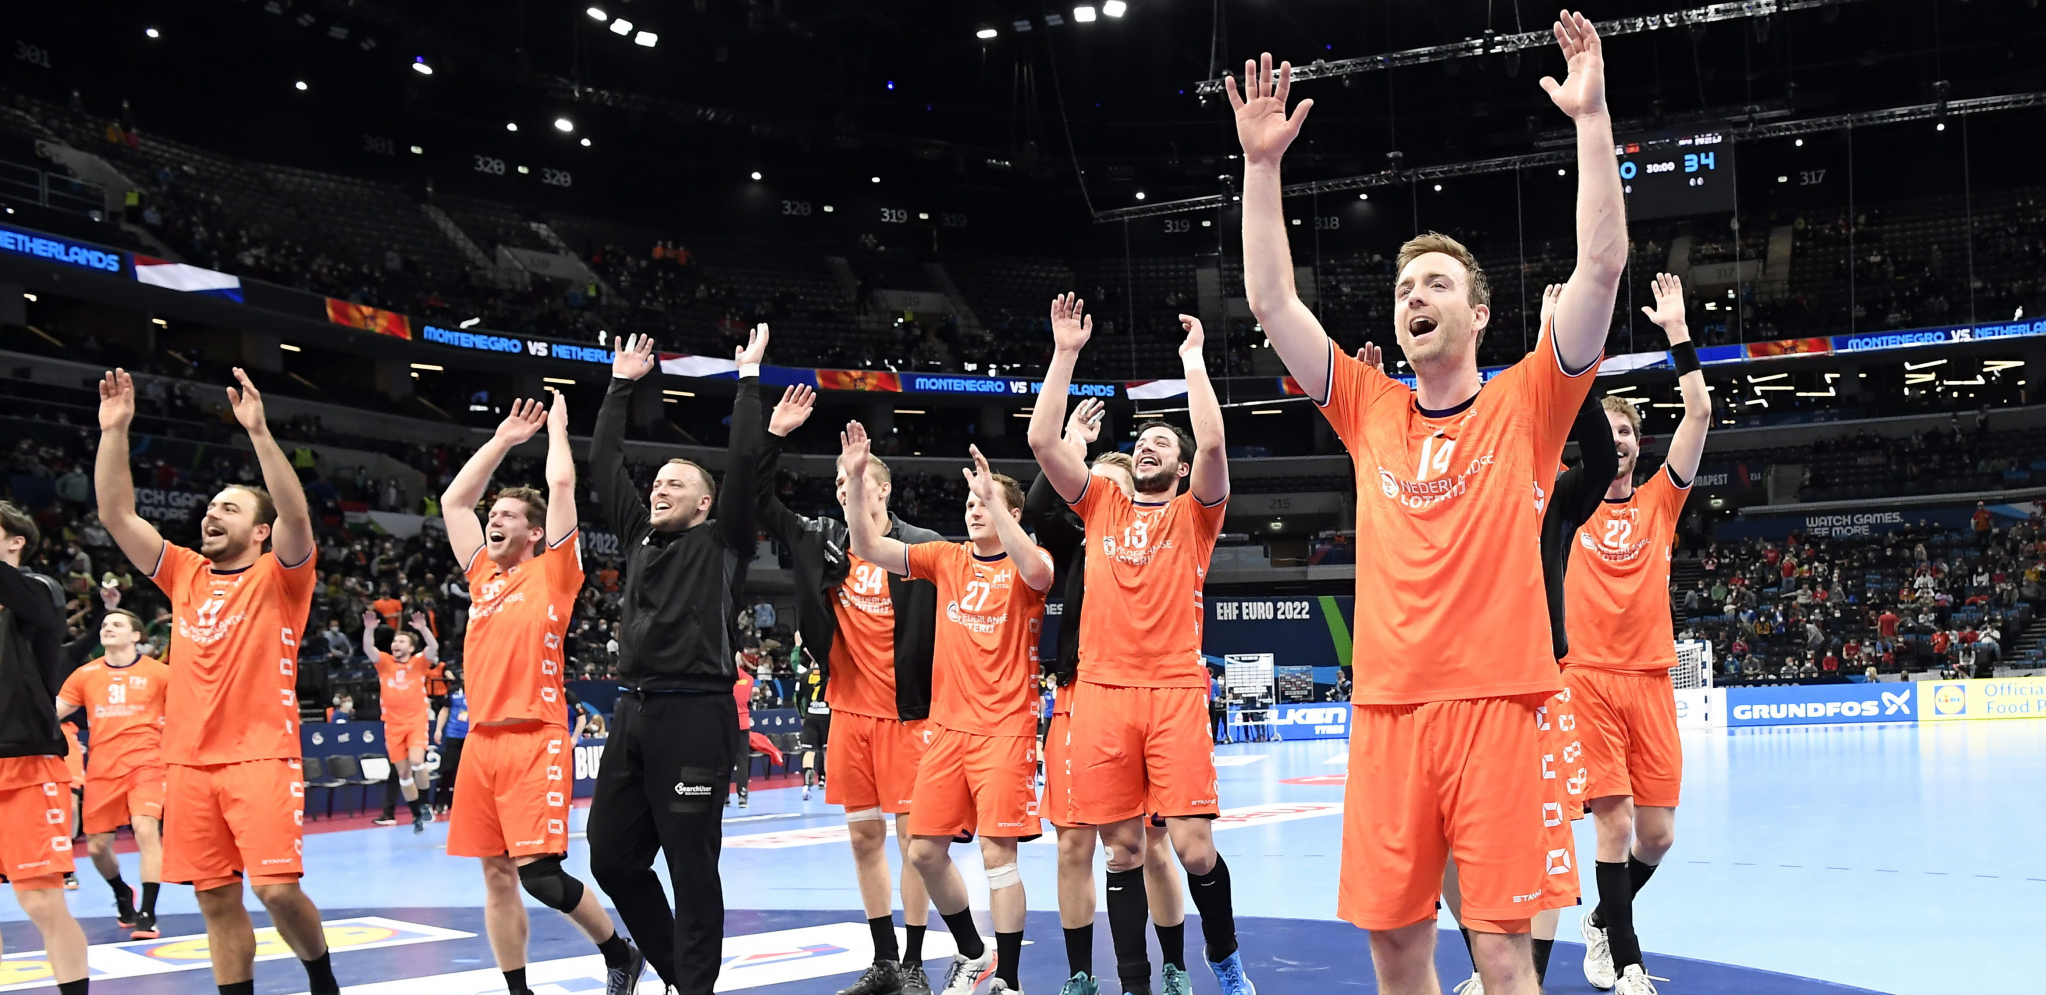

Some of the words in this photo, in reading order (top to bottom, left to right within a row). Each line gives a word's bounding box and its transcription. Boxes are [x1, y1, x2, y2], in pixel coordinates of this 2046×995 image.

[473, 154, 506, 176] 320
[1619, 161, 1637, 180] 0
[1646, 161, 1676, 174] 30:00
[1684, 151, 1715, 173] 34
[541, 167, 572, 187] 320
[1800, 169, 1826, 186] 317
[781, 199, 812, 217] 320
[880, 207, 908, 224] 319
[1164, 219, 1190, 233] 319
[1315, 216, 1340, 230] 318
[424, 326, 522, 353] MONTENEGRO
[526, 341, 548, 356] VS
[552, 344, 617, 364] NETHERL
[1848, 331, 1945, 351] MONTENEGRO
[1950, 328, 1970, 343] VS
[1975, 320, 2046, 339] NETHERLA
[915, 378, 1005, 393] MONTENEGRO
[1010, 381, 1028, 394] VS
[1031, 382, 1115, 397] NRLANDS
[1416, 436, 1456, 481] 14
[1694, 474, 1728, 487] UDAPEST
[134, 488, 166, 506] TCH
[1270, 498, 1290, 509] 215
[1806, 515, 1851, 527] WATCH
[1854, 512, 1904, 524] GAMES.
[1124, 520, 1148, 548] 13
[1604, 520, 1632, 548] 22
[1832, 525, 1870, 537] MORE
[589, 532, 618, 554] 2022
[854, 565, 882, 594] 34
[960, 580, 990, 612] 27
[1216, 602, 1240, 620] EHF
[1242, 602, 1274, 620] EURO
[1277, 601, 1310, 620] 2022
[108, 684, 126, 704] 31
[1733, 700, 1880, 720] GRUNDFOS
[1987, 700, 2030, 714] Food
